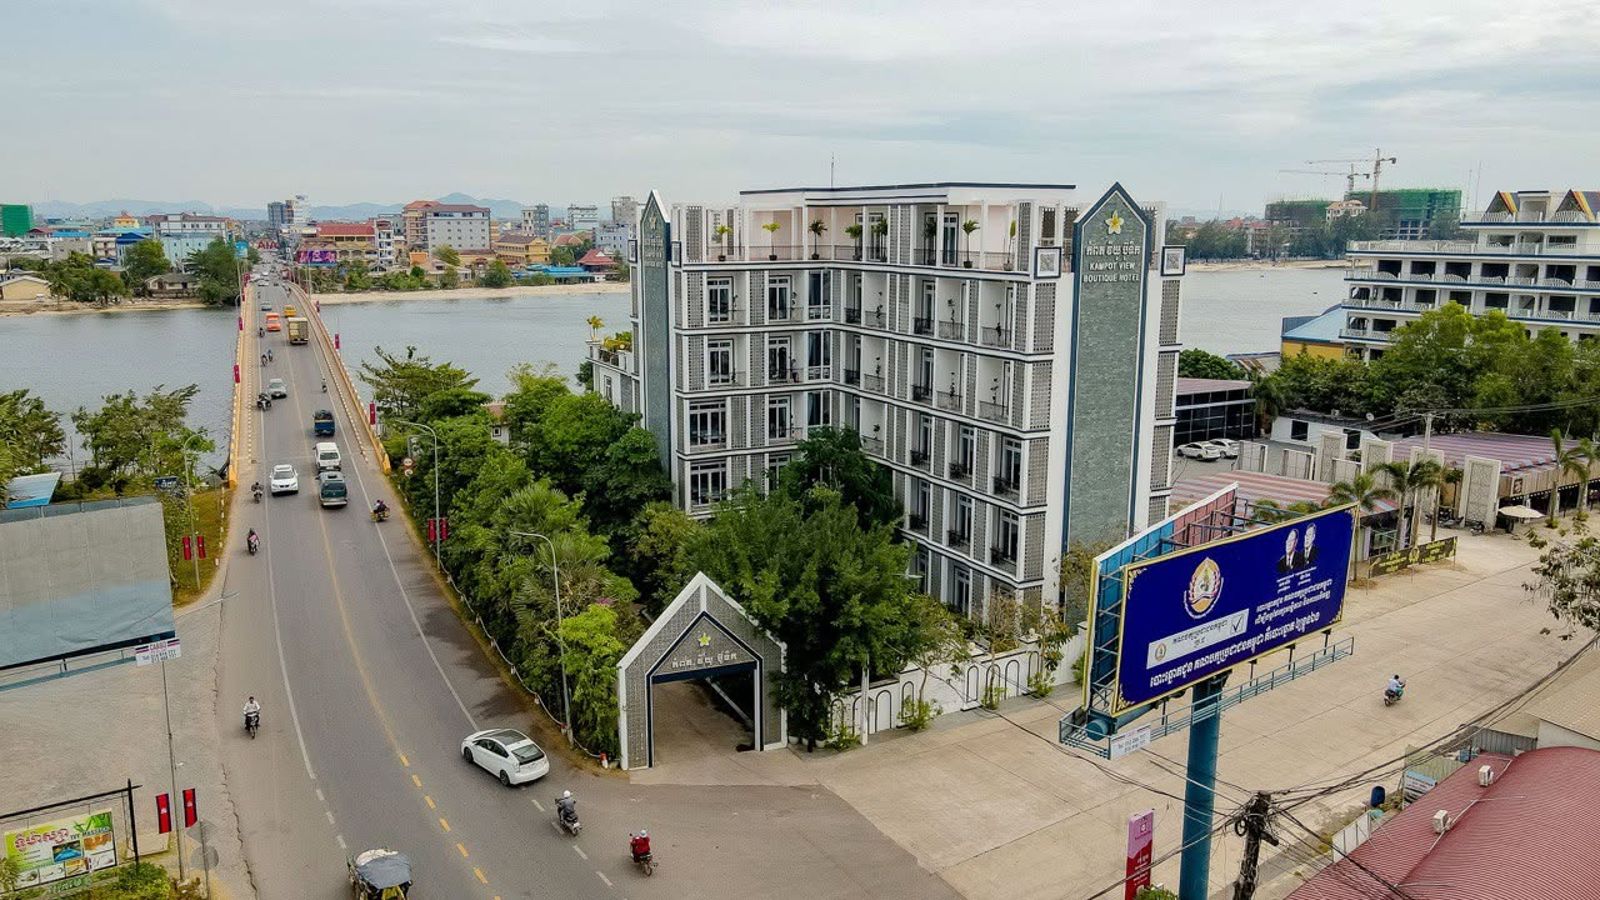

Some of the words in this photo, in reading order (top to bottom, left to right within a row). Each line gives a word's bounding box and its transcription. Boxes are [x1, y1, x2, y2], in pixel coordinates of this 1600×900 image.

[1089, 261, 1117, 271] KAMPOT
[1118, 261, 1136, 270] VIEW
[1083, 273, 1117, 283] BOUTIQUE
[1118, 273, 1140, 282] HOTEL
